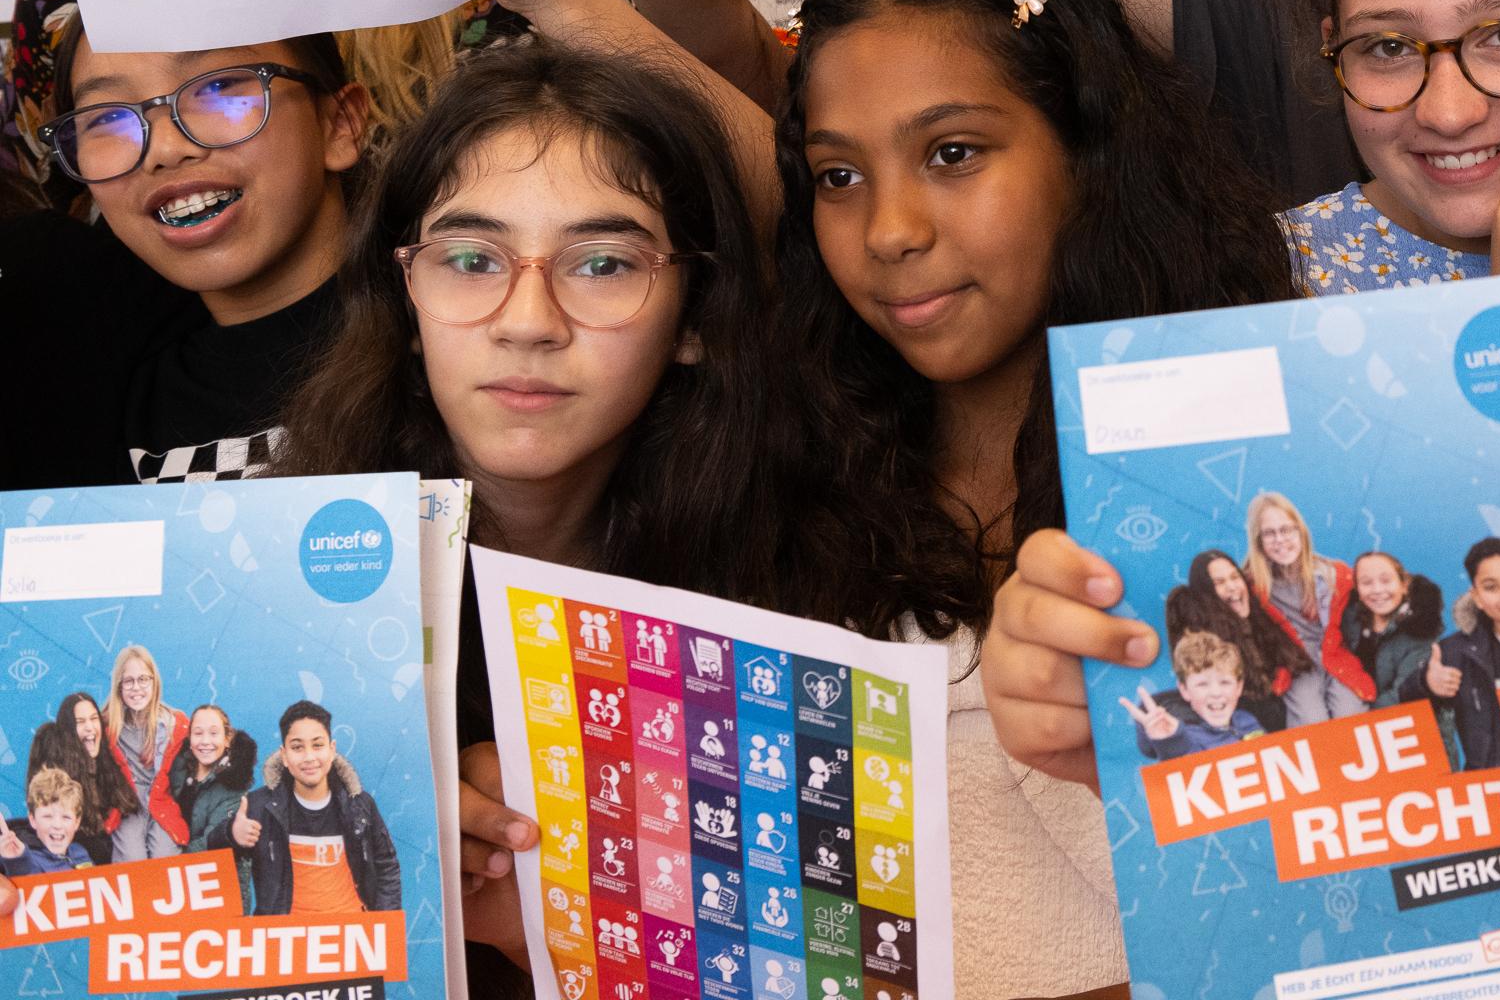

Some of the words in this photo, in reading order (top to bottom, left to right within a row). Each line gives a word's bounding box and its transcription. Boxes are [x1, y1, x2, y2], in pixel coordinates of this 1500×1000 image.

[309, 530, 361, 551] unicef
[310, 564, 332, 573] voor
[334, 561, 359, 572] ieder
[361, 560, 382, 570] kind
[1165, 739, 1320, 828] KEN
[1339, 715, 1428, 784] JE
[13, 873, 135, 936] KEN
[152, 861, 224, 915] JE
[107, 923, 387, 982] RECHTEN
[1388, 960, 1426, 976] NAAM
[1429, 953, 1473, 969] NODIG?
